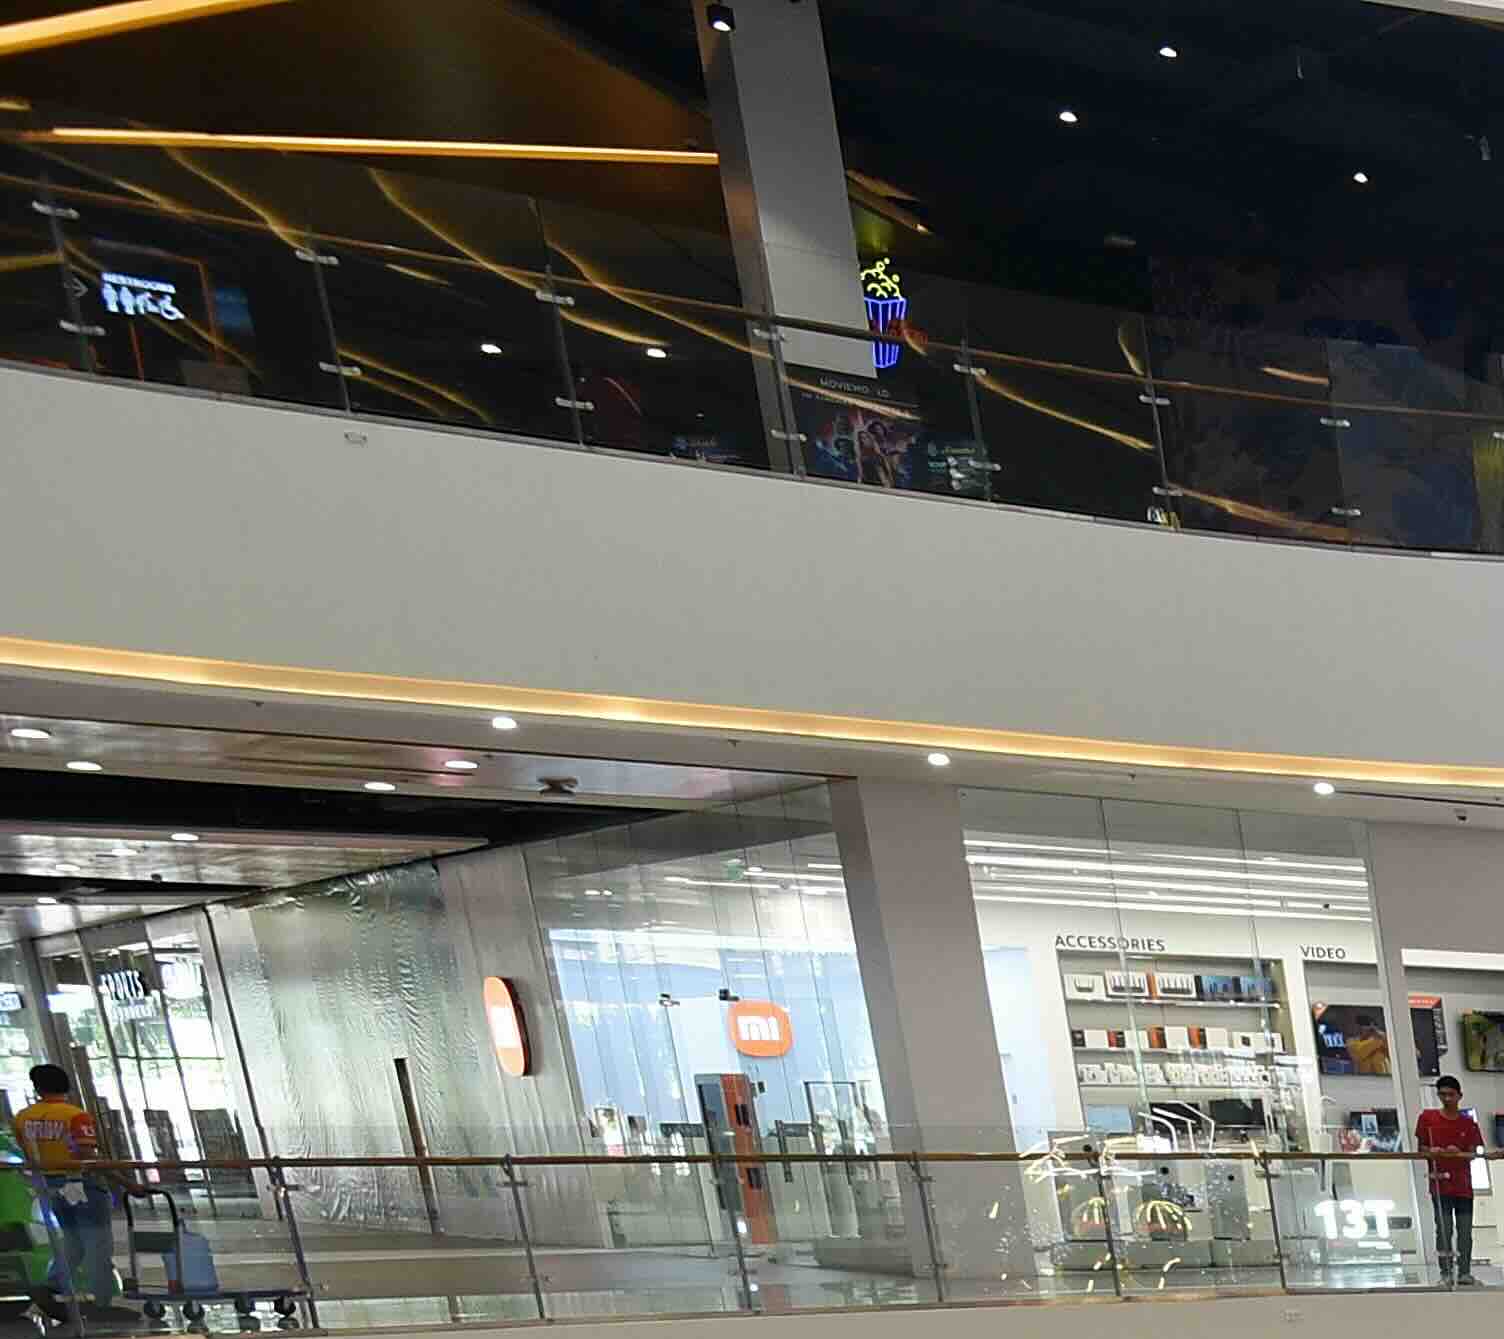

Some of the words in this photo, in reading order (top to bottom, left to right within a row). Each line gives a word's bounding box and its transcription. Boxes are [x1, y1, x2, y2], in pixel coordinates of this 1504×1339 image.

[820, 377, 890, 399] MOVIEWOLD
[1055, 935, 1165, 952] ACCESSORIES
[1300, 945, 1346, 960] VIDEO
